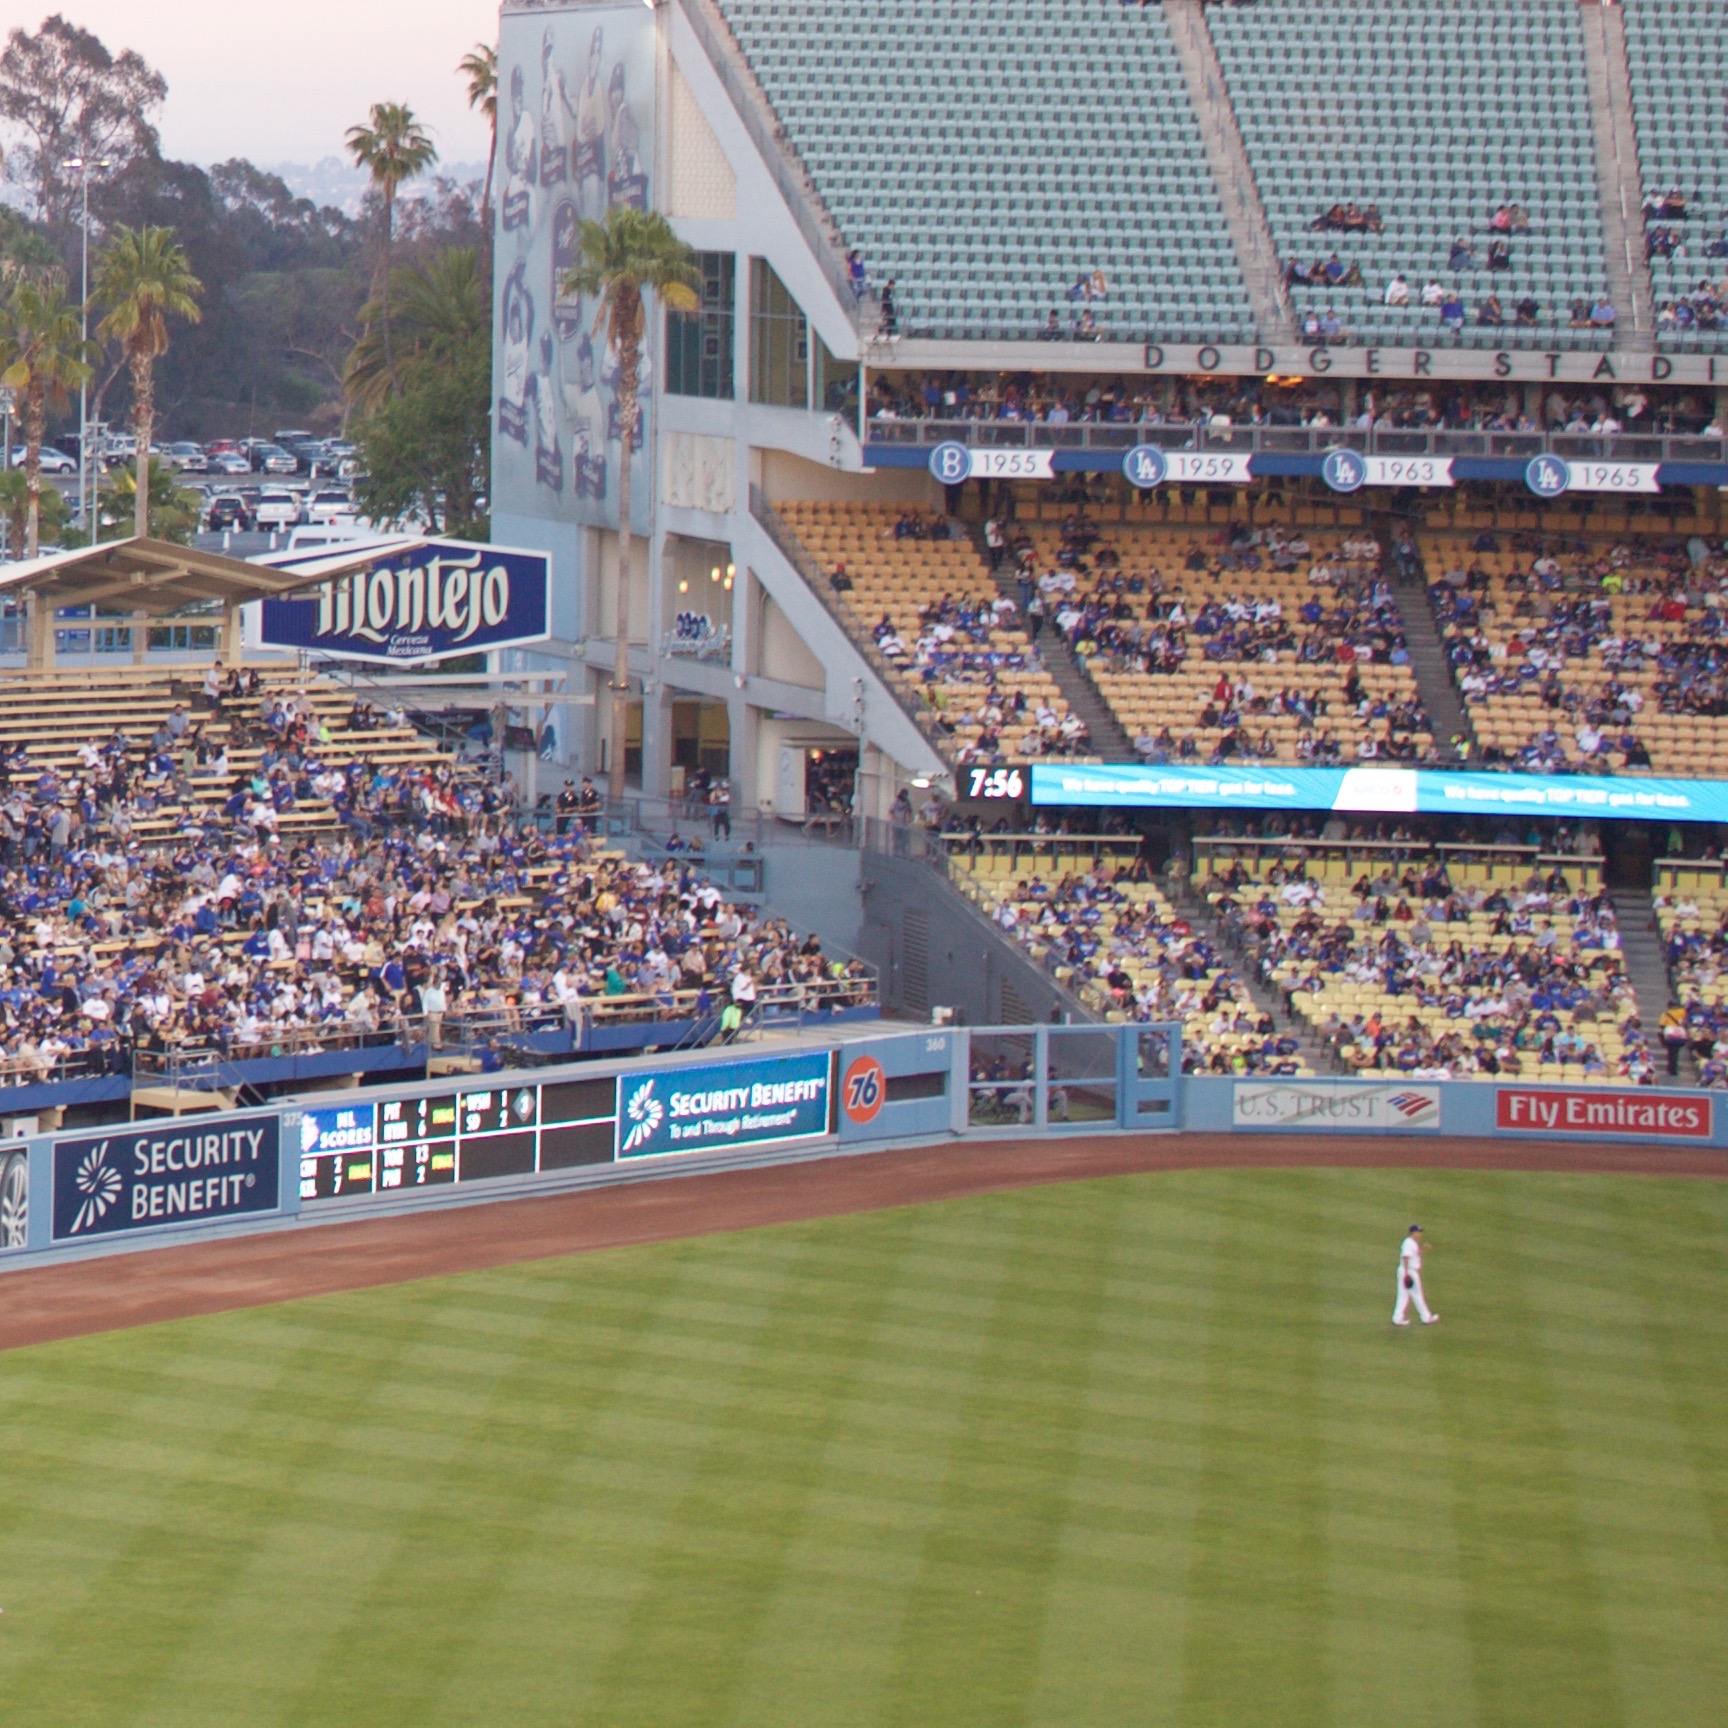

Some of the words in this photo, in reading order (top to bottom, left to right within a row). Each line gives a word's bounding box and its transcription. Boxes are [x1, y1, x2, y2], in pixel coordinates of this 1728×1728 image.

[1143, 345, 1432, 377] DODGER
[982, 453, 1037, 474] 1955
[1177, 456, 1234, 477] 1959
[1378, 460, 1434, 481] 1963
[1583, 466, 1640, 487] 1965
[317, 550, 509, 644] Montejo
[387, 644, 433, 657] Mexicana
[390, 634, 429, 646] Cerveza
[970, 769, 1023, 798] 7:56
[1062, 779, 1083, 792] We
[1084, 780, 1115, 793] have
[1115, 780, 1160, 795] quality
[1160, 779, 1186, 793] TOP
[1187, 779, 1217, 793] TIER
[1218, 783, 1242, 796] gas
[1243, 781, 1262, 795] for
[1444, 786, 1466, 799] We
[1467, 787, 1500, 800] have
[1500, 787, 1545, 803] quality
[1547, 786, 1574, 801] TOP
[1575, 788, 1608, 803] TIER
[1608, 792, 1634, 806] gas
[1635, 790, 1656, 805] for
[925, 1037, 946, 1052] 360
[501, 1090, 508, 1108] 1
[669, 1087, 750, 1117] SECURITY
[751, 1078, 819, 1108] BENEFIT
[846, 1067, 880, 1110] 76
[1239, 1095, 1285, 1118] U.S.
[1291, 1095, 1380, 1119] TRUST
[1509, 1095, 1558, 1127] Fly
[1566, 1098, 1700, 1129] Emirates
[499, 1109, 508, 1128] 2
[669, 1123, 682, 1139] To
[682, 1120, 701, 1137] and
[702, 1116, 741, 1136] Through
[741, 1110, 793, 1130] Retirement
[320, 1127, 372, 1149] SCORES
[134, 1129, 264, 1176] SECURITY
[416, 1144, 429, 1164] 13
[334, 1176, 342, 1194] 7
[417, 1165, 425, 1184] 2
[132, 1174, 246, 1220] BENEFIT
